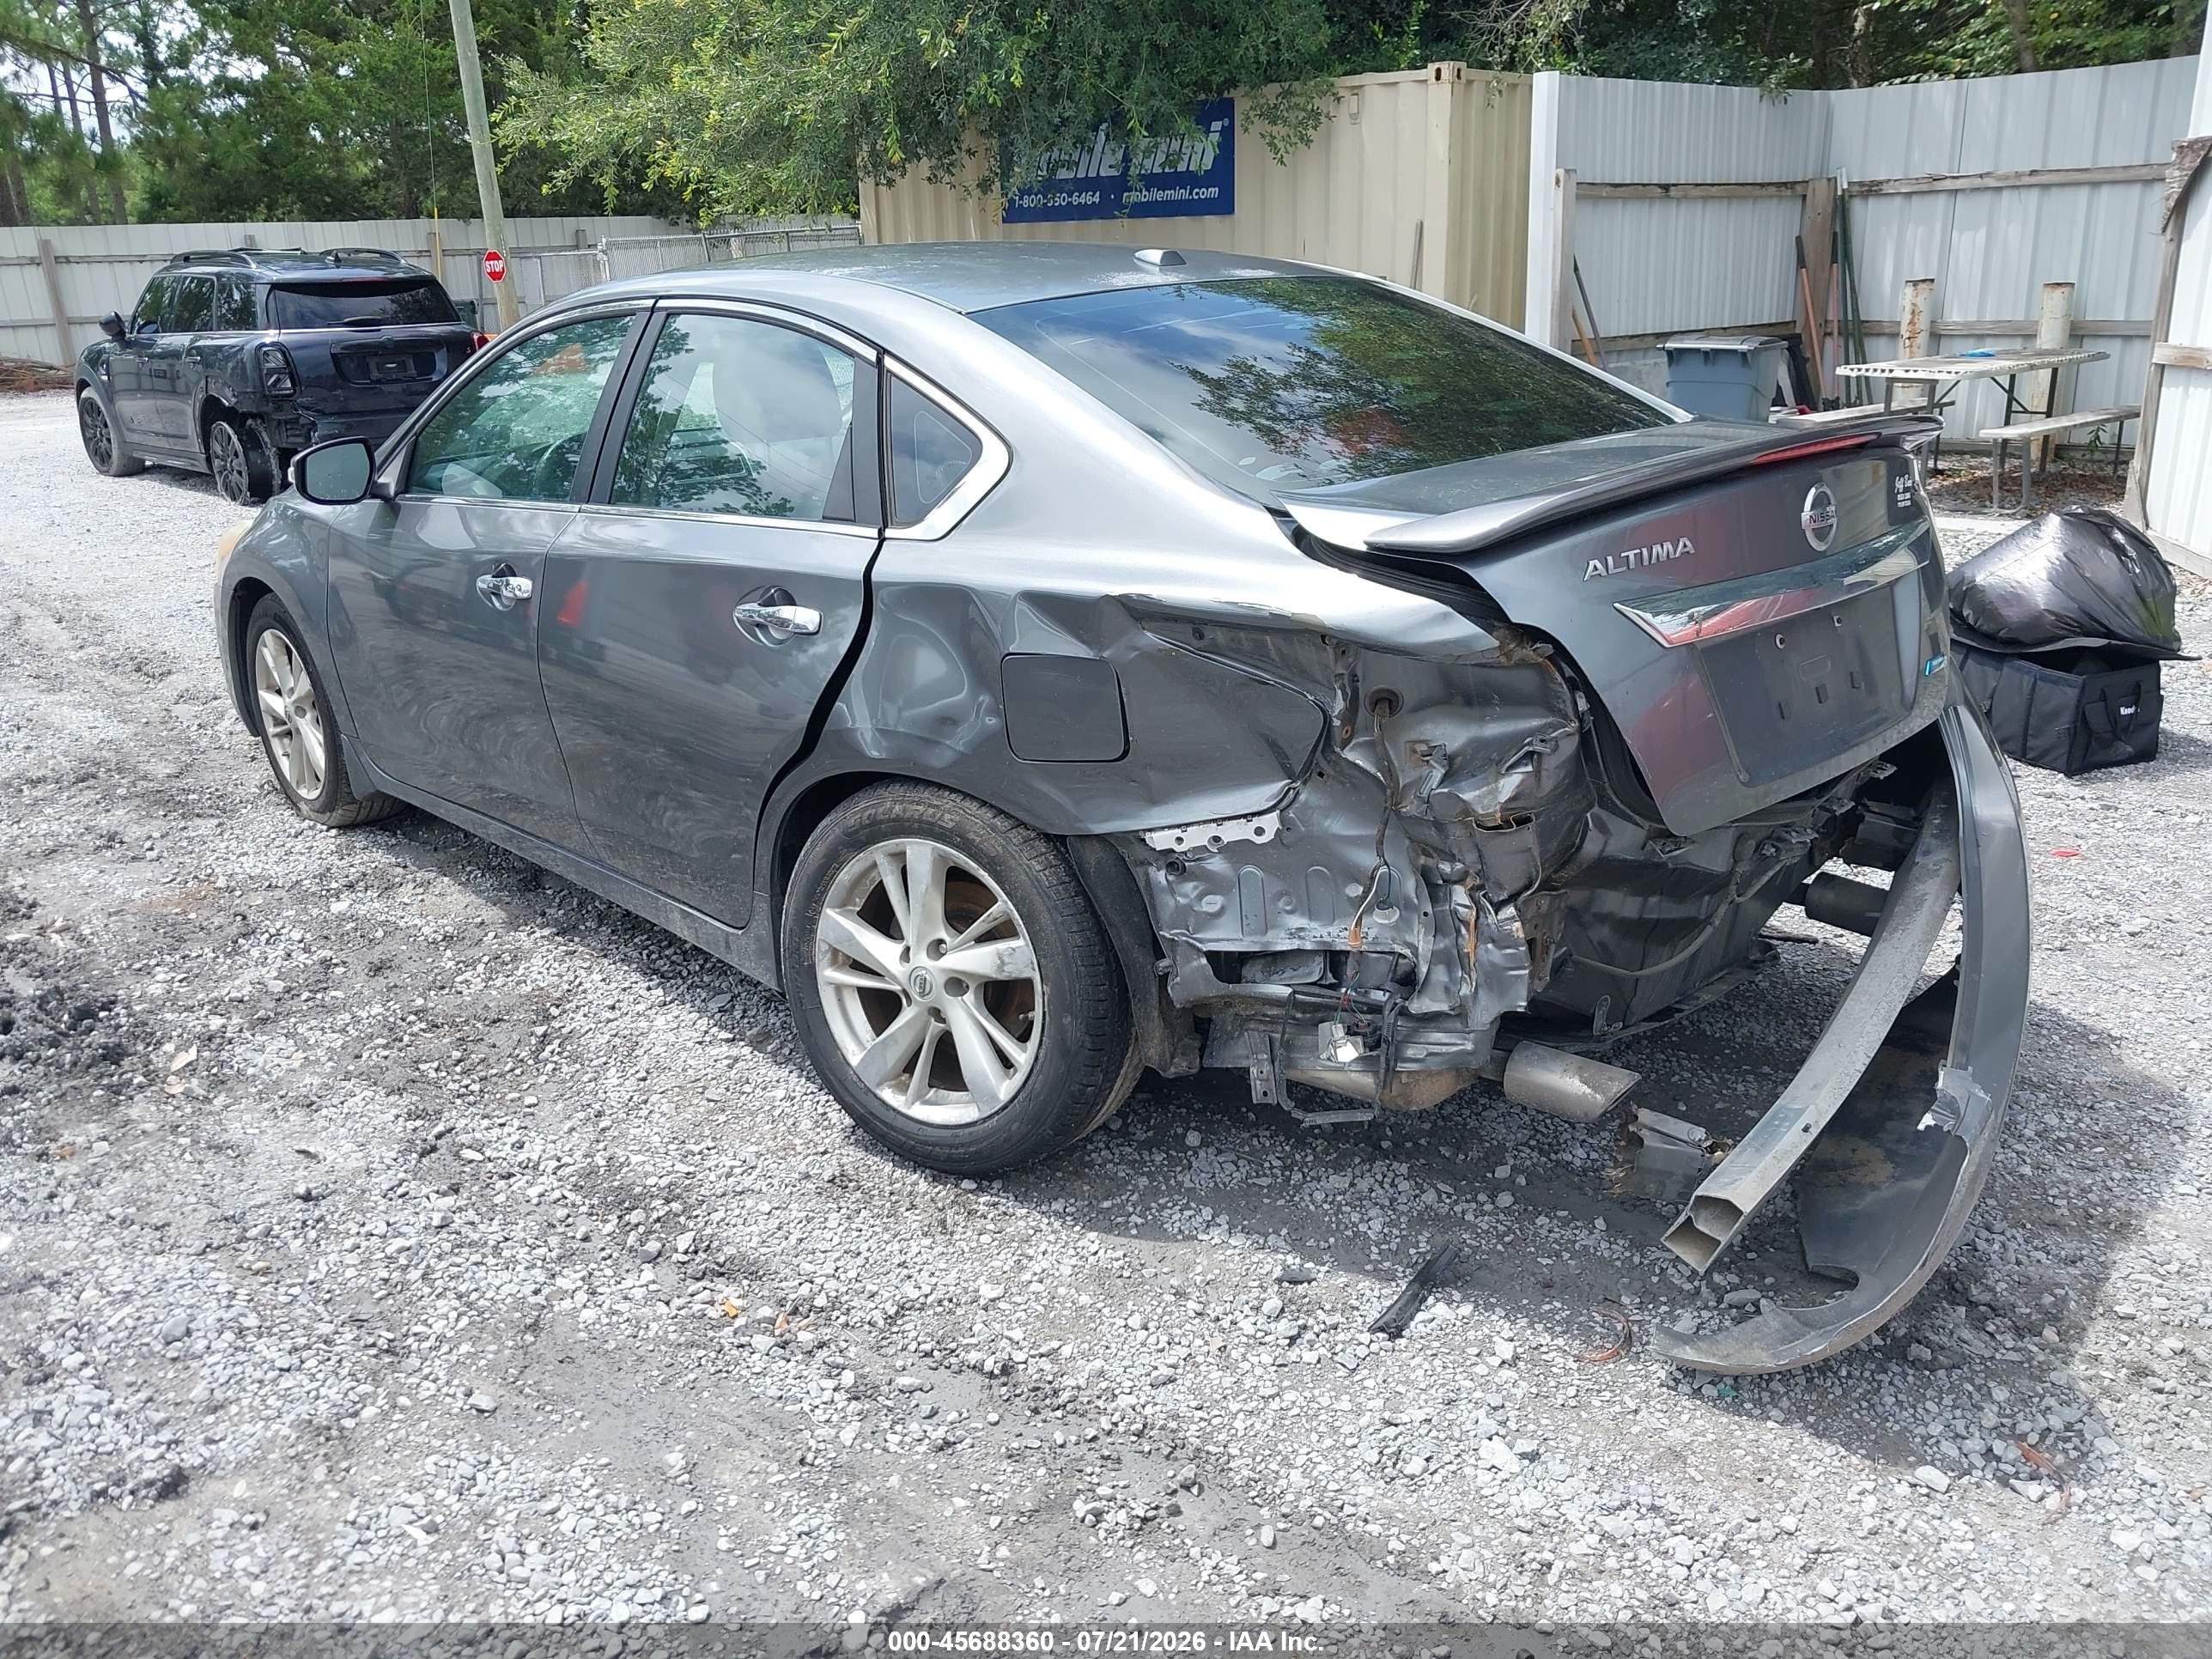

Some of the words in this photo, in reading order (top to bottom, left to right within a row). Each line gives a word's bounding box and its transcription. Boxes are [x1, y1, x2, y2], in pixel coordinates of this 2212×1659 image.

[1122, 185, 1219, 204] mobilemini.com
[485, 259, 503, 273] STOP
[1809, 509, 1837, 525] NISSA
[1583, 537, 1696, 582] ALTIMA
